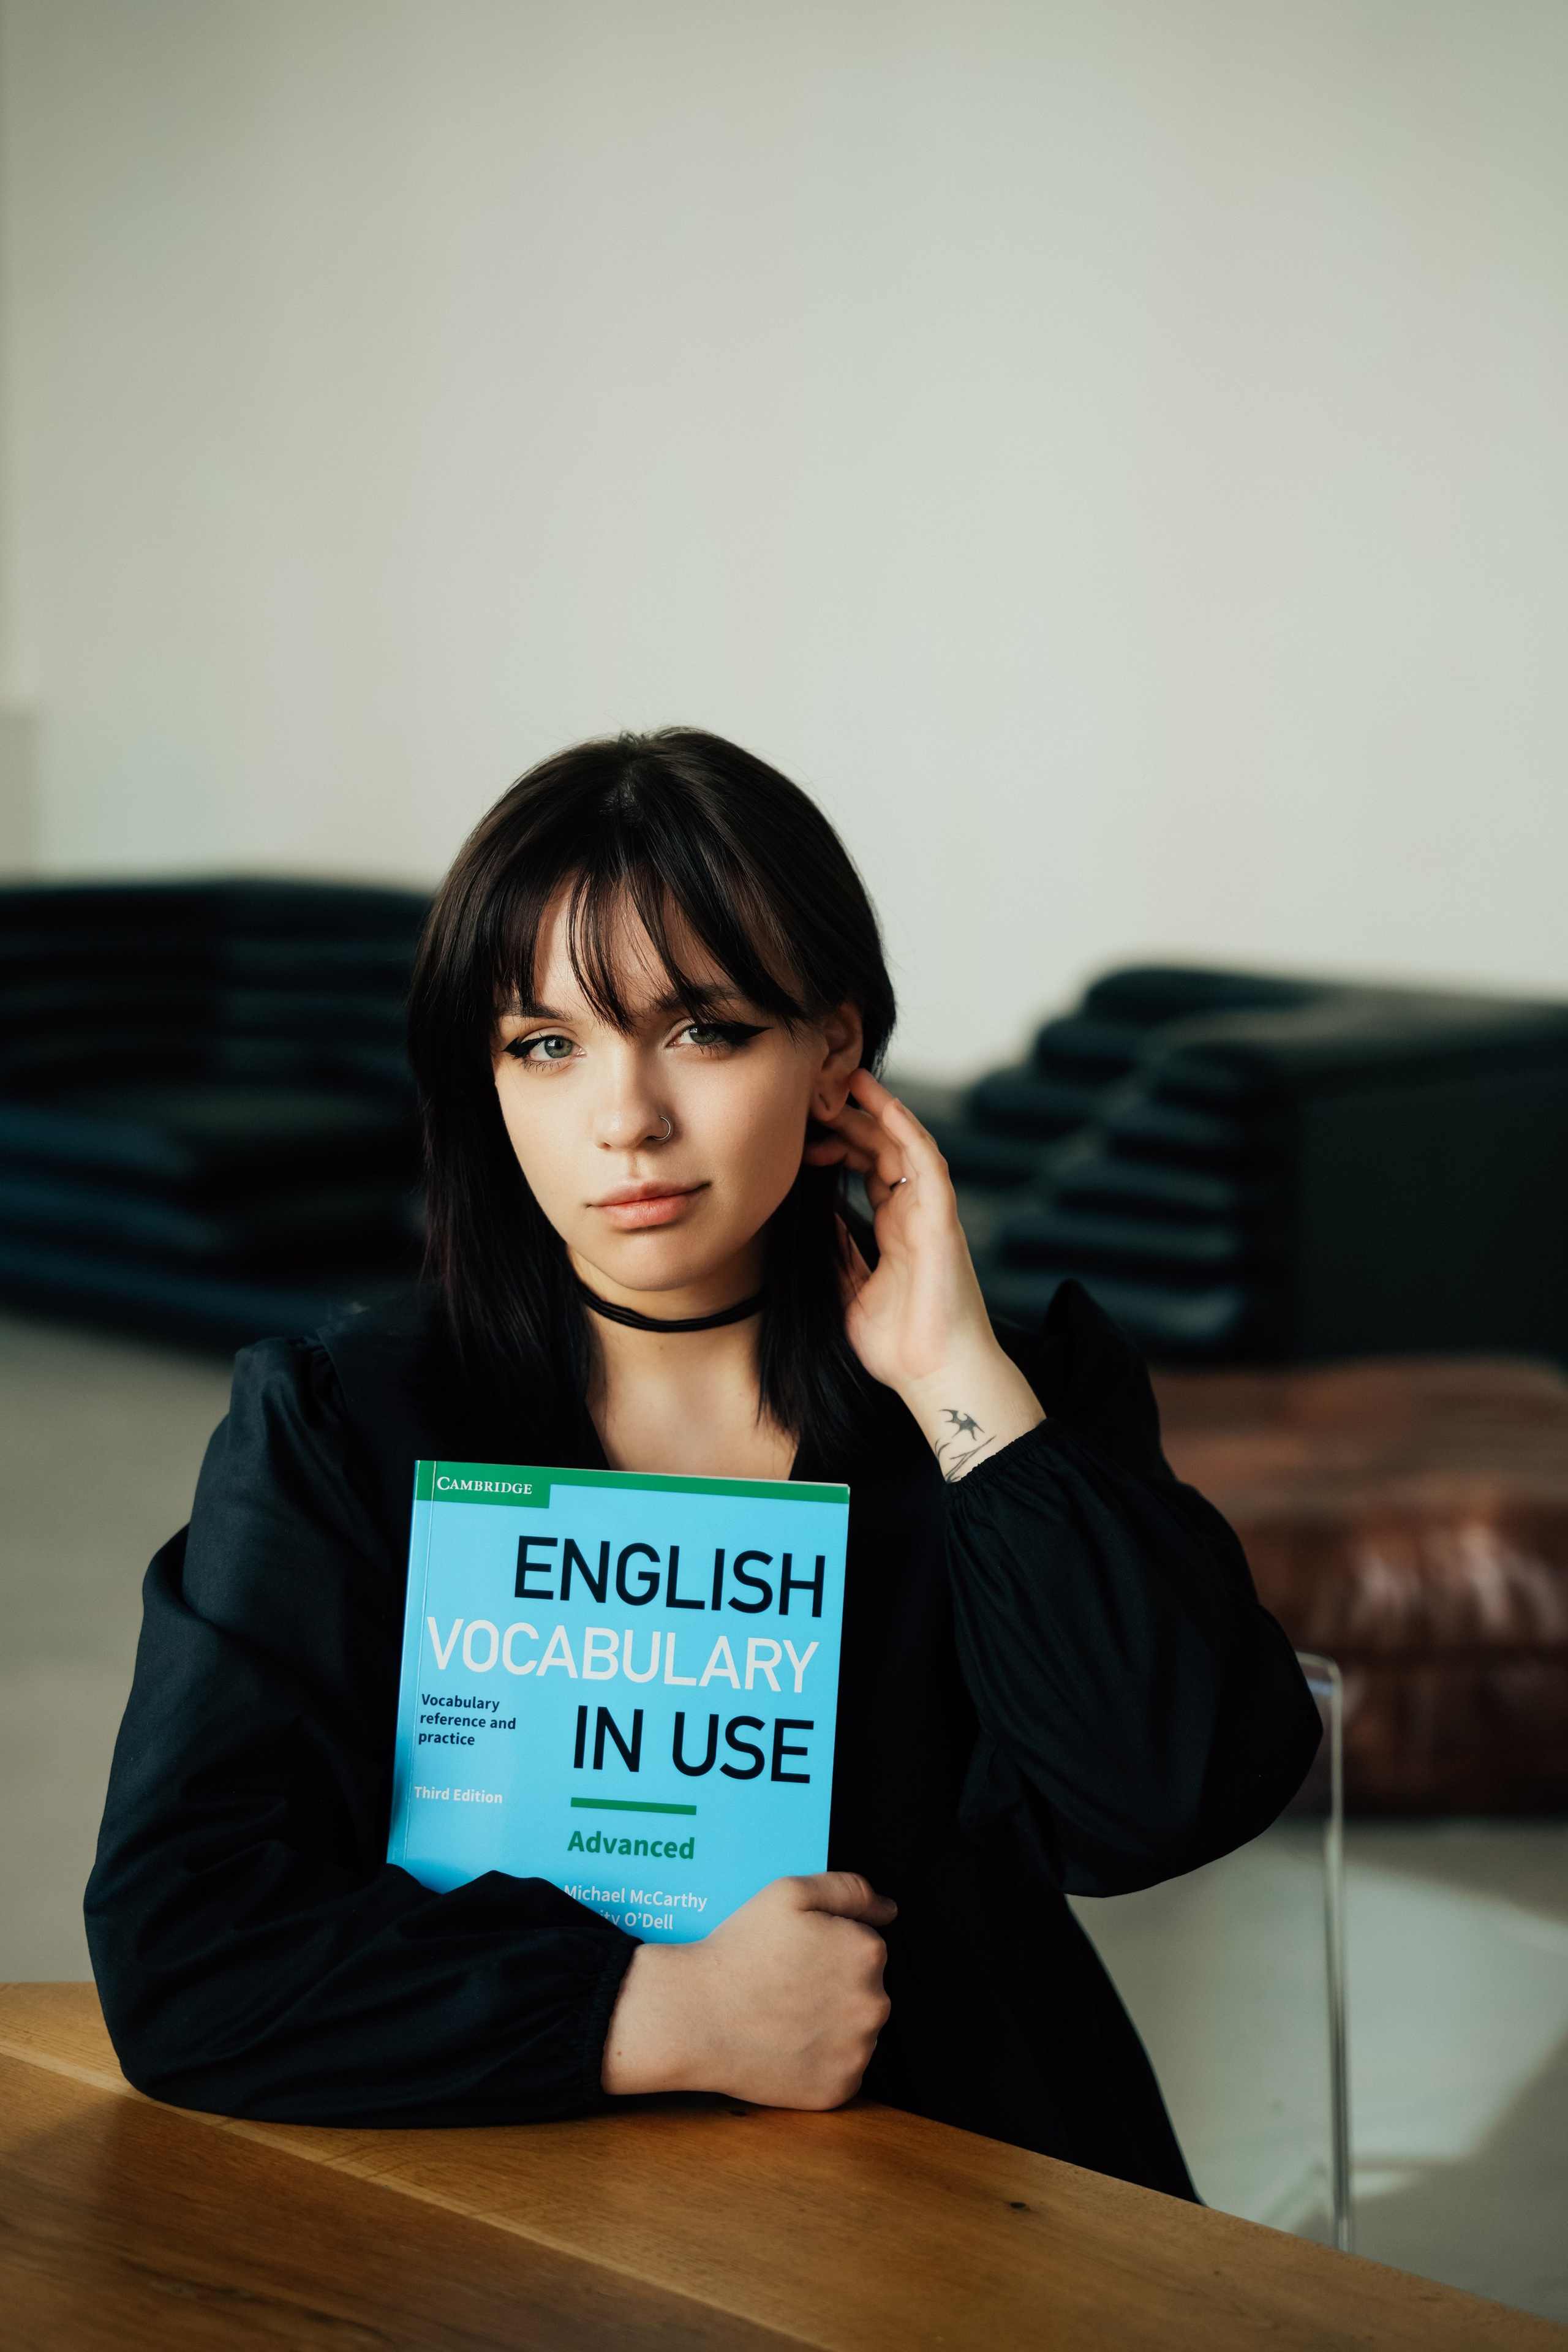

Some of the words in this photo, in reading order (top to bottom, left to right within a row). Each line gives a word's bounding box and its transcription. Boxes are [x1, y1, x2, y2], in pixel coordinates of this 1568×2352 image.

[514, 1536, 826, 1618] ENGLISH
[426, 1616, 820, 1694] VOCABULARY
[421, 1694, 500, 1713] Vocabulary
[420, 1712, 486, 1728] reference
[489, 1717, 516, 1730] and
[418, 1732, 475, 1746] practice
[573, 1705, 643, 1773] IN
[673, 1711, 815, 1784] USE
[414, 1786, 450, 1800] Third
[453, 1789, 503, 1803] Edition
[567, 1830, 695, 1859] Advanced
[564, 1885, 625, 1903] Michael
[630, 1890, 708, 1912] McCarthy
